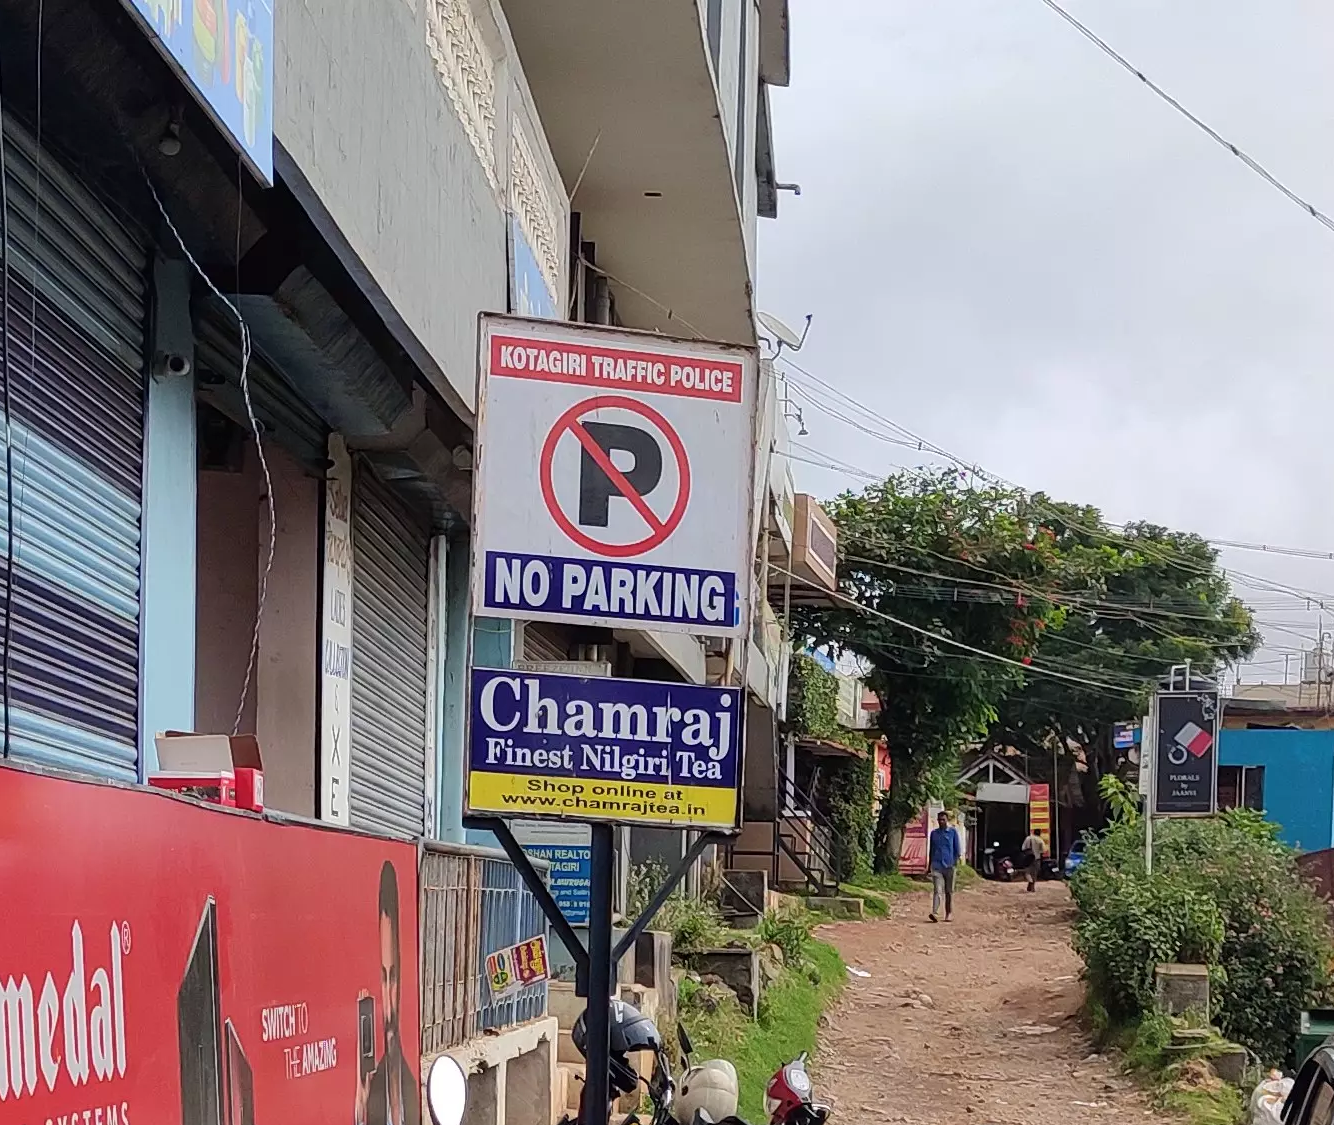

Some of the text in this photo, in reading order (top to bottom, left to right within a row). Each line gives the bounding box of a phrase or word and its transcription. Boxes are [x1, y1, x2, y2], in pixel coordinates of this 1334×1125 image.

[500, 345, 734, 393] KOTAGIRI TRAFFIC POLICE
[579, 420, 662, 528] P
[494, 557, 726, 622] NO PARKING
[480, 677, 732, 761] Chamraj
[486, 737, 723, 780] Finest Nilgiri Tea
[501, 793, 706, 817] www.chamrajtea.in
[527, 779, 683, 801] Shop online at
[549, 862, 579, 872] TAGIRI
[261, 1002, 309, 1042] SWITCH TO
[284, 1037, 337, 1079] THE AMAZING
